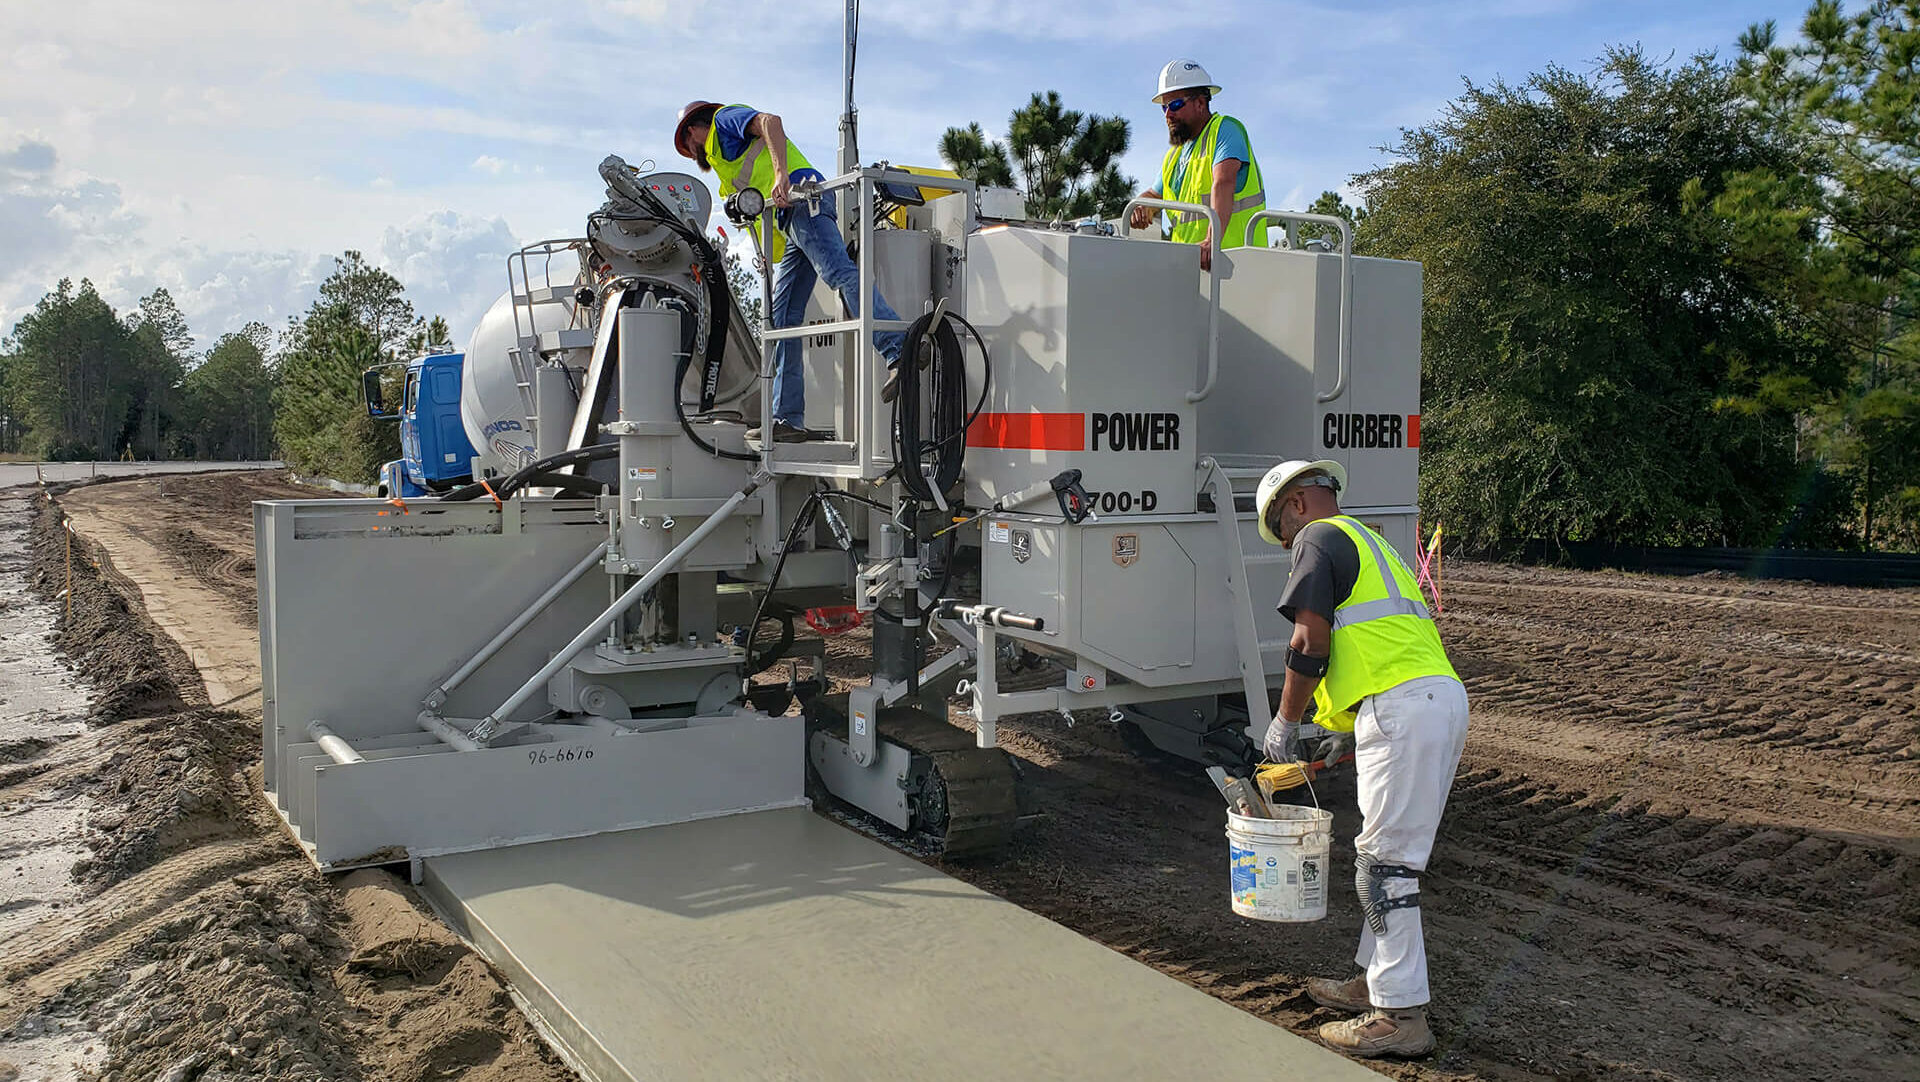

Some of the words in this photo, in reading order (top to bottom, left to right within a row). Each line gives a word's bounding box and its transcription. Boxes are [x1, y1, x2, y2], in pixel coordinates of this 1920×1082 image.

[704, 360, 720, 400] PROTEC
[1092, 412, 1180, 452] POWER
[1323, 412, 1402, 449] CURBER
[1069, 490, 1157, 514] 700-D
